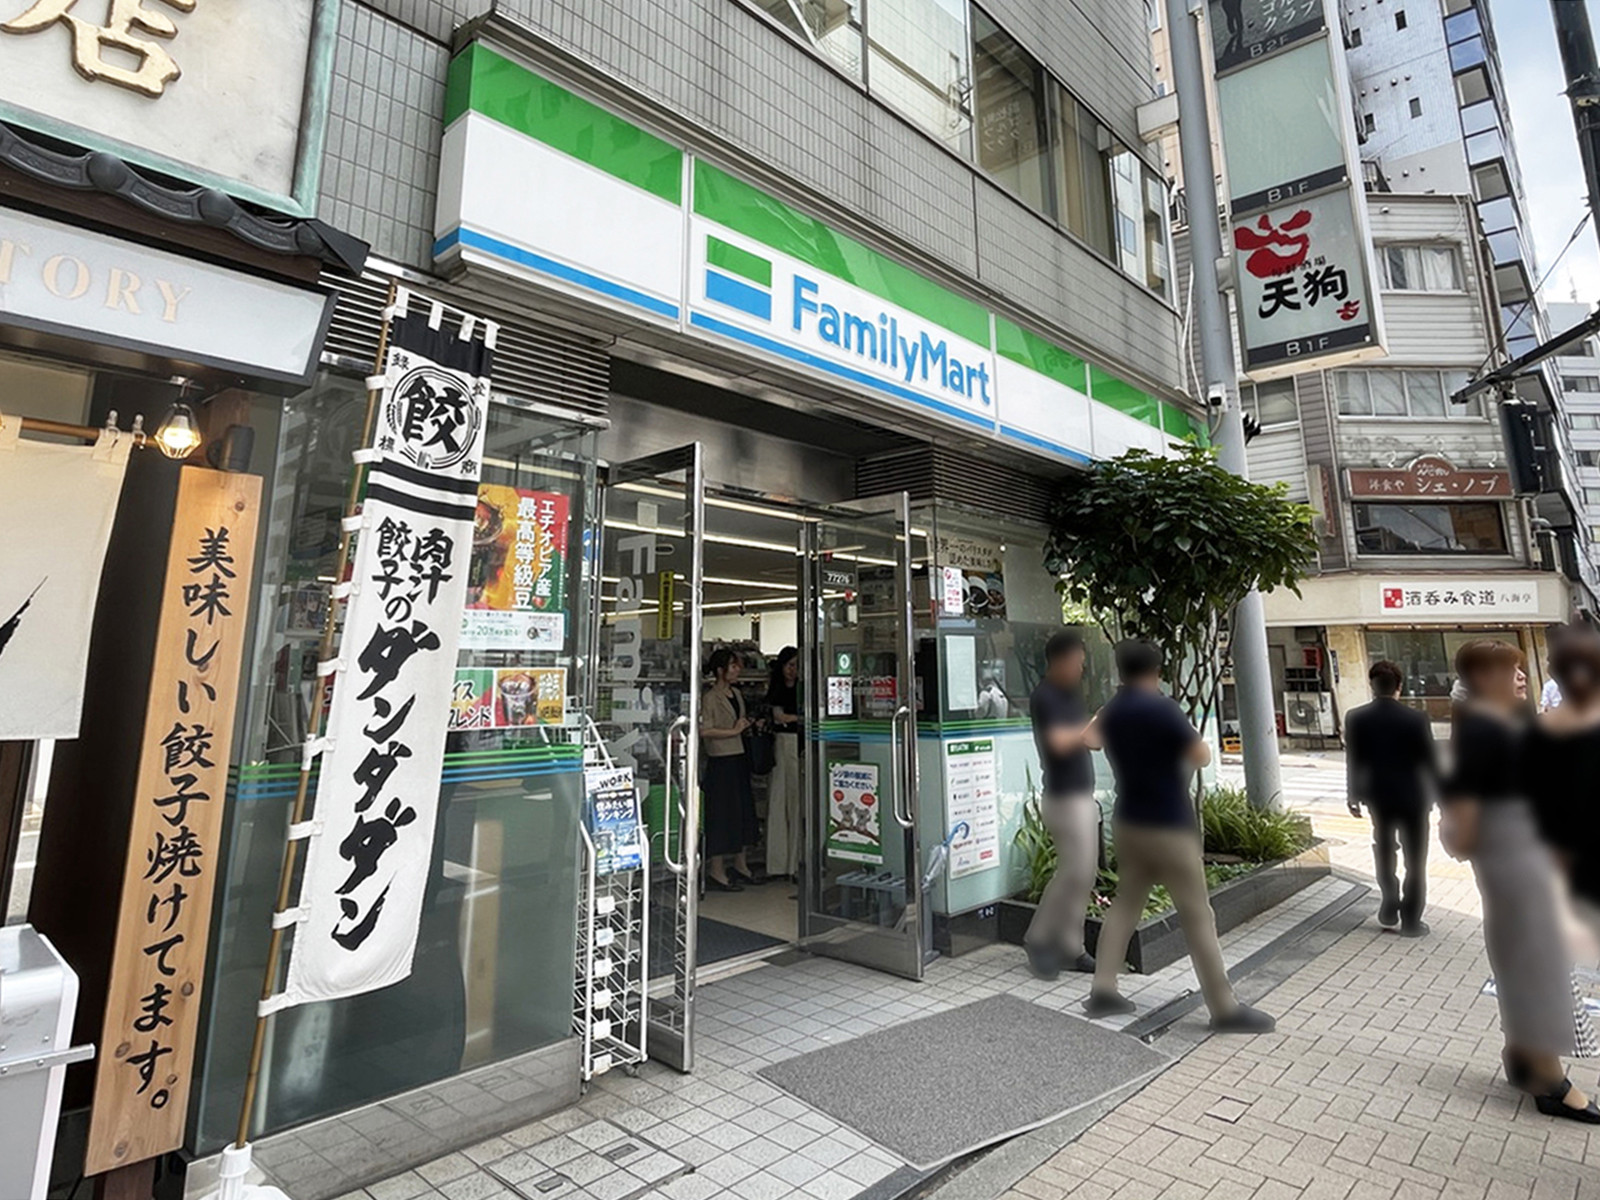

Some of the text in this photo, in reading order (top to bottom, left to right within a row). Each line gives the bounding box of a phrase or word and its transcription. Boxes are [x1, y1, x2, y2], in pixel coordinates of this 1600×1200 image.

[1250, 34, 1290, 58] B2F
[1268, 181, 1310, 203] B1F
[1258, 264, 1349, 319] 天狗
[791, 273, 991, 407] FamilyMart
[1286, 336, 1330, 357] B1F
[371, 516, 412, 623] 餃子の
[406, 527, 454, 605] 肉汁
[512, 497, 537, 610] 最高等級豆
[535, 500, 556, 597] エチオピア産
[1405, 590, 1496, 606] 酒呑み食道
[126, 526, 236, 1110] 美味しい餃子焼けてます。
[330, 620, 441, 951] ダンダダン
